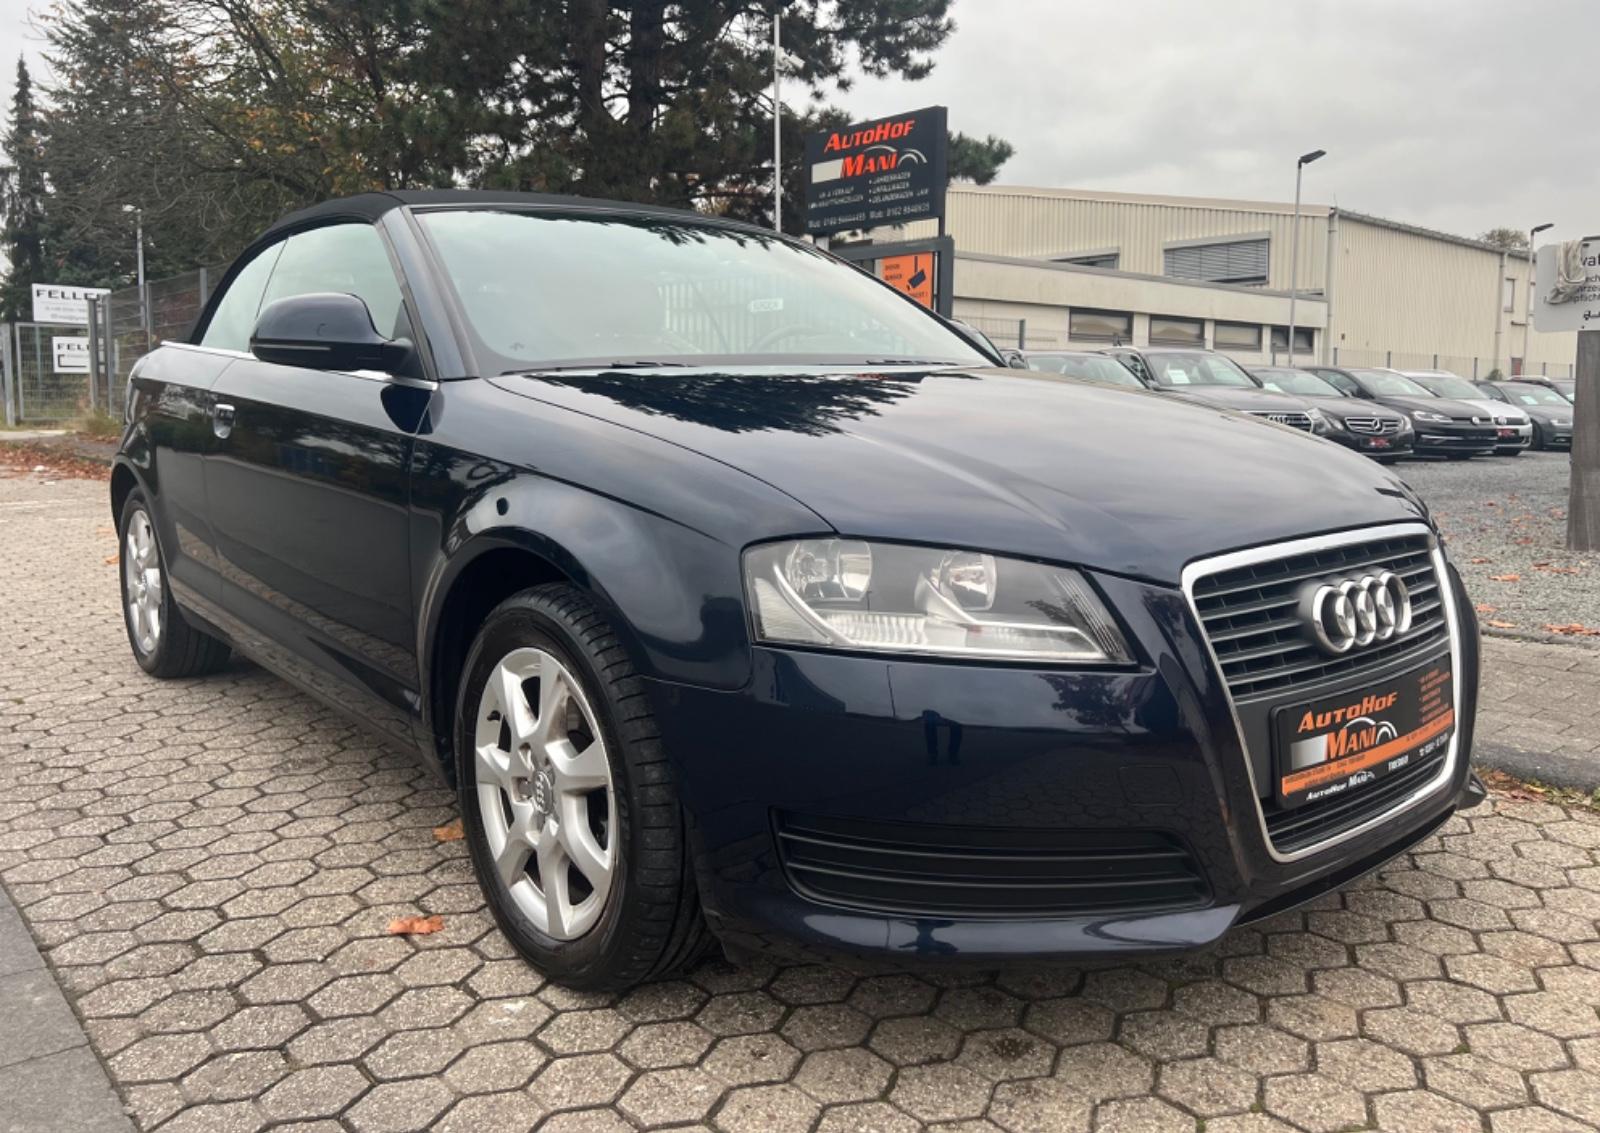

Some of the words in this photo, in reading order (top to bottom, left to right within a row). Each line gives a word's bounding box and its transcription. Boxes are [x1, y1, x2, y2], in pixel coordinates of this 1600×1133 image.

[824, 120, 915, 153] AUTOHOF
[841, 153, 898, 178] MANI
[1297, 691, 1399, 733] AUTOHOF
[1326, 725, 1378, 760] MANI
